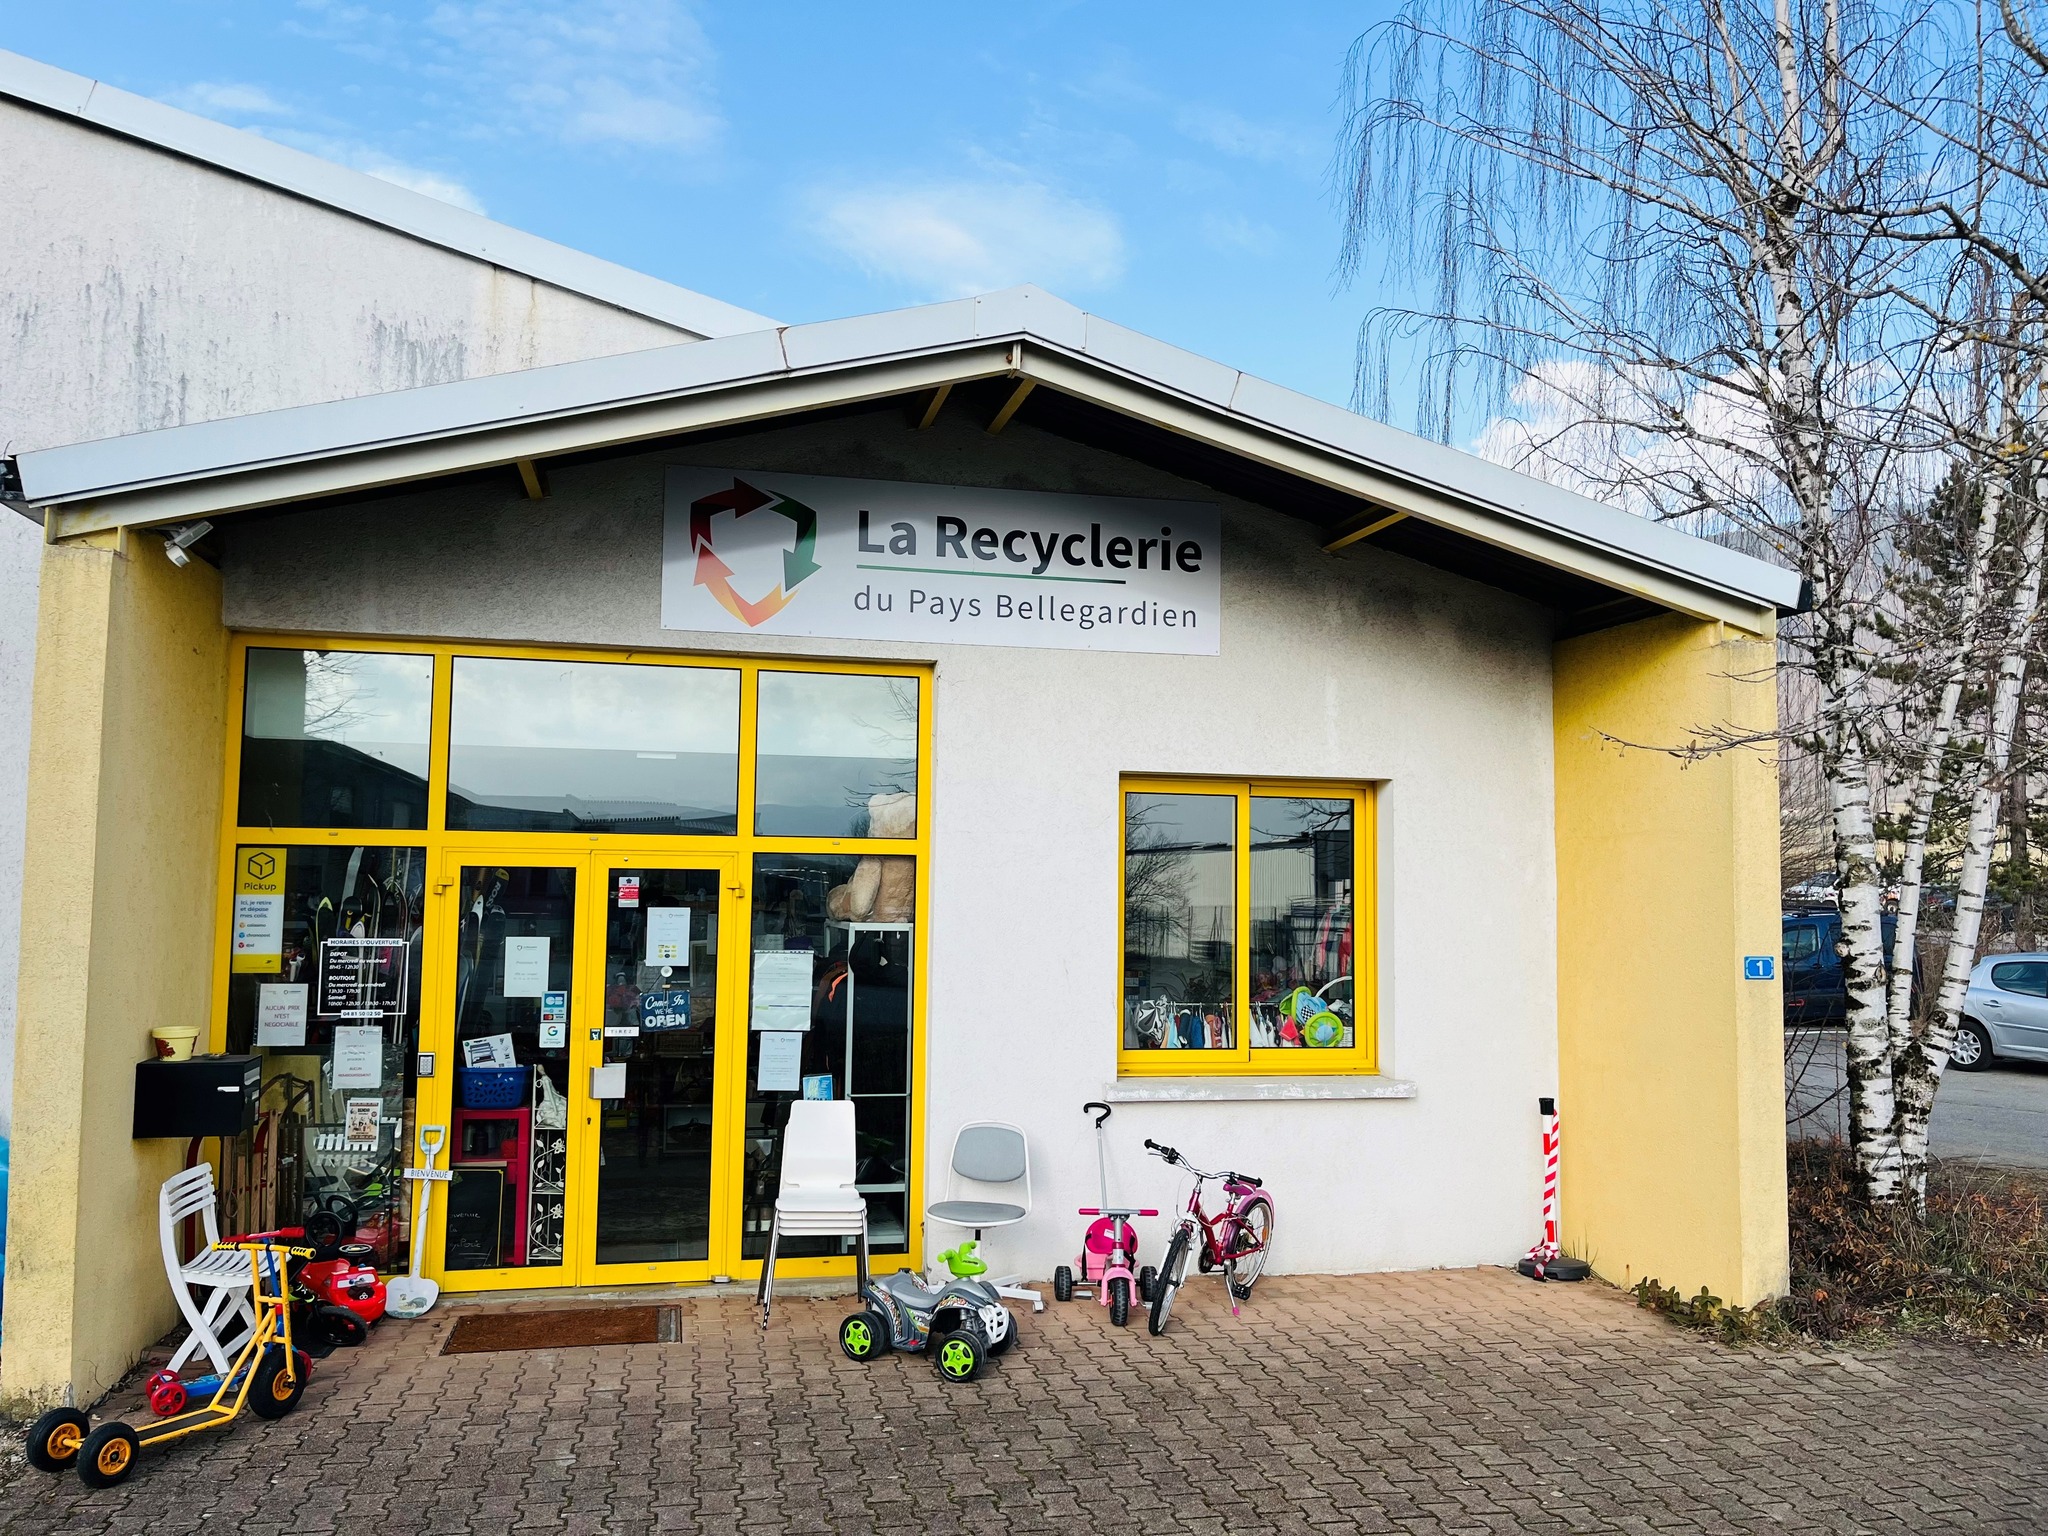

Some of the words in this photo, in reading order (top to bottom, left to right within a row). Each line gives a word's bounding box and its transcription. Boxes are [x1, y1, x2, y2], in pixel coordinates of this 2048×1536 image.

[857, 509, 918, 556] La
[935, 514, 1203, 575] Recyclerie
[853, 585, 894, 613] du
[909, 588, 982, 623] Pays
[996, 593, 1198, 630] Bellegardien
[244, 882, 277, 891] Pickup
[1756, 960, 1764, 976] 1
[671, 994, 685, 1006] In
[644, 1013, 686, 1028] OPEN
[410, 1169, 449, 1179] BIENVENUE
